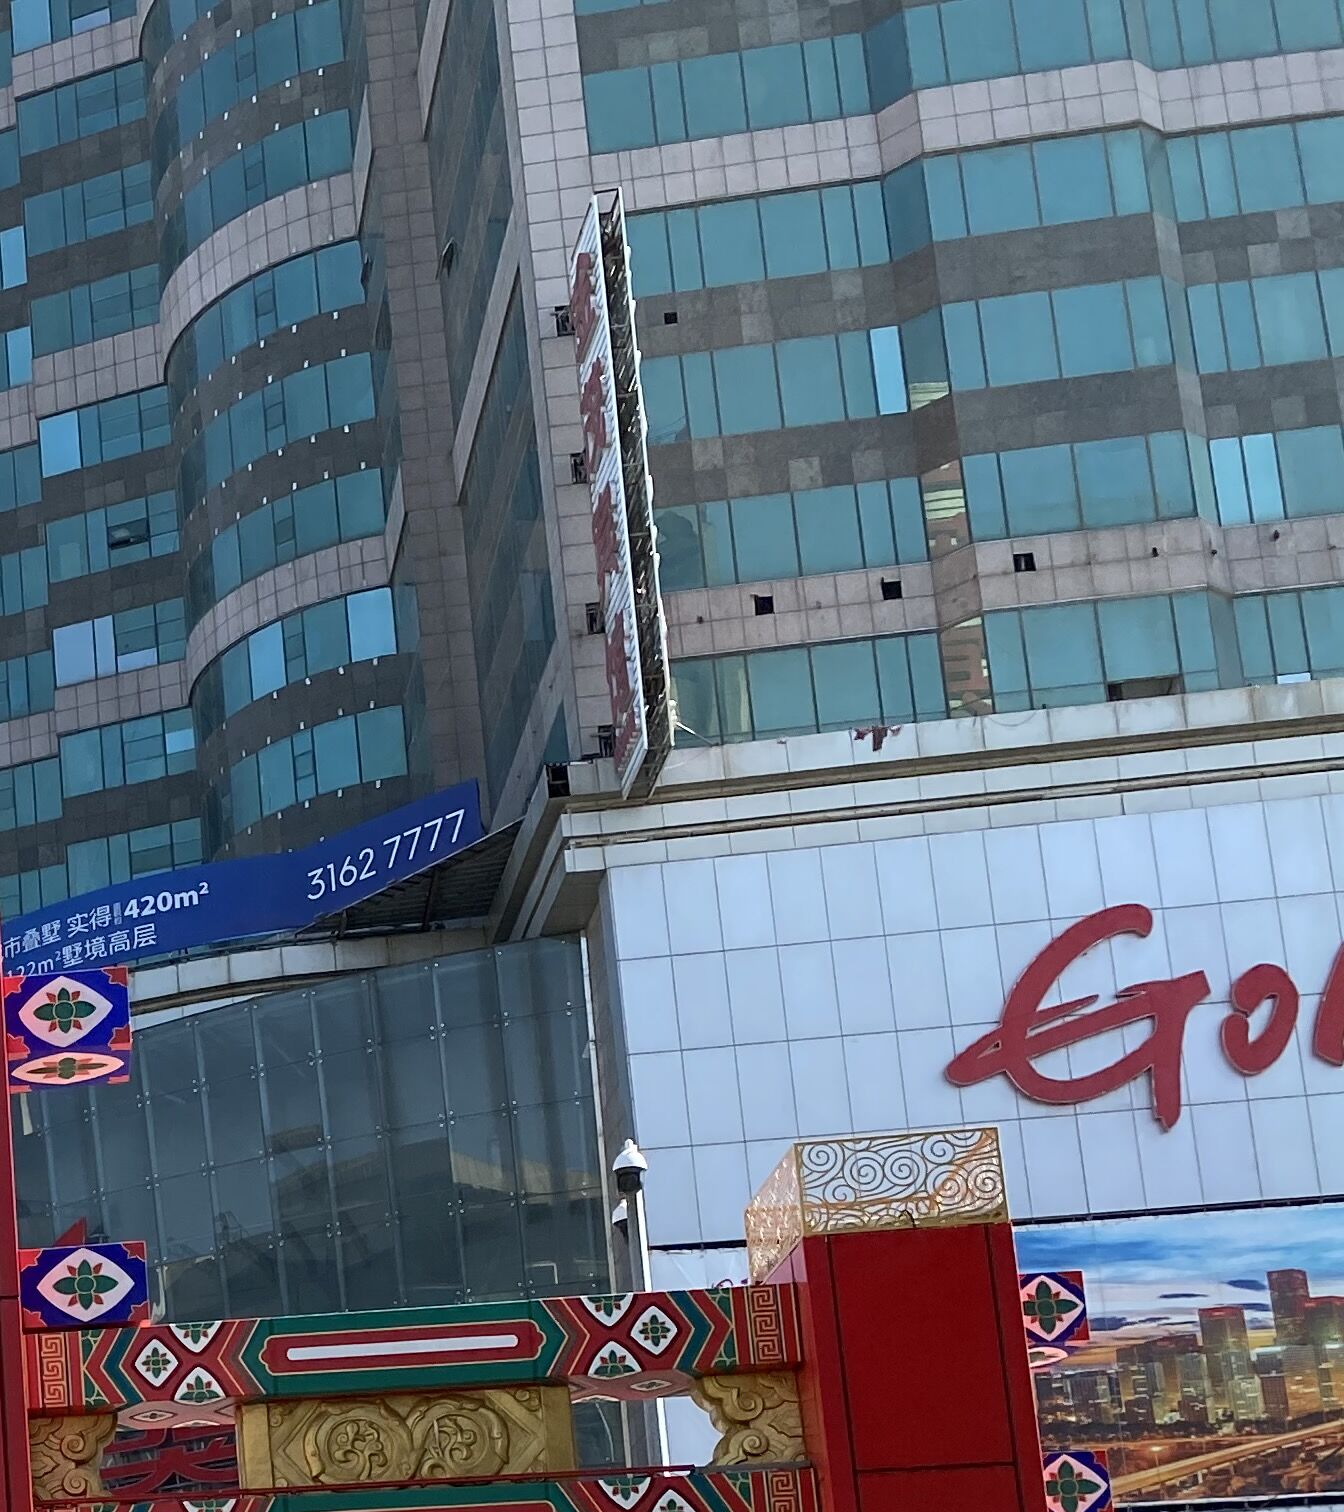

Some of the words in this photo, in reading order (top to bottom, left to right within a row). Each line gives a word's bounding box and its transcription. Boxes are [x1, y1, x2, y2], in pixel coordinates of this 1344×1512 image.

[307, 847, 378, 901] 3162
[384, 808, 466, 868] 7777
[1, 919, 62, 963] 市叠墅
